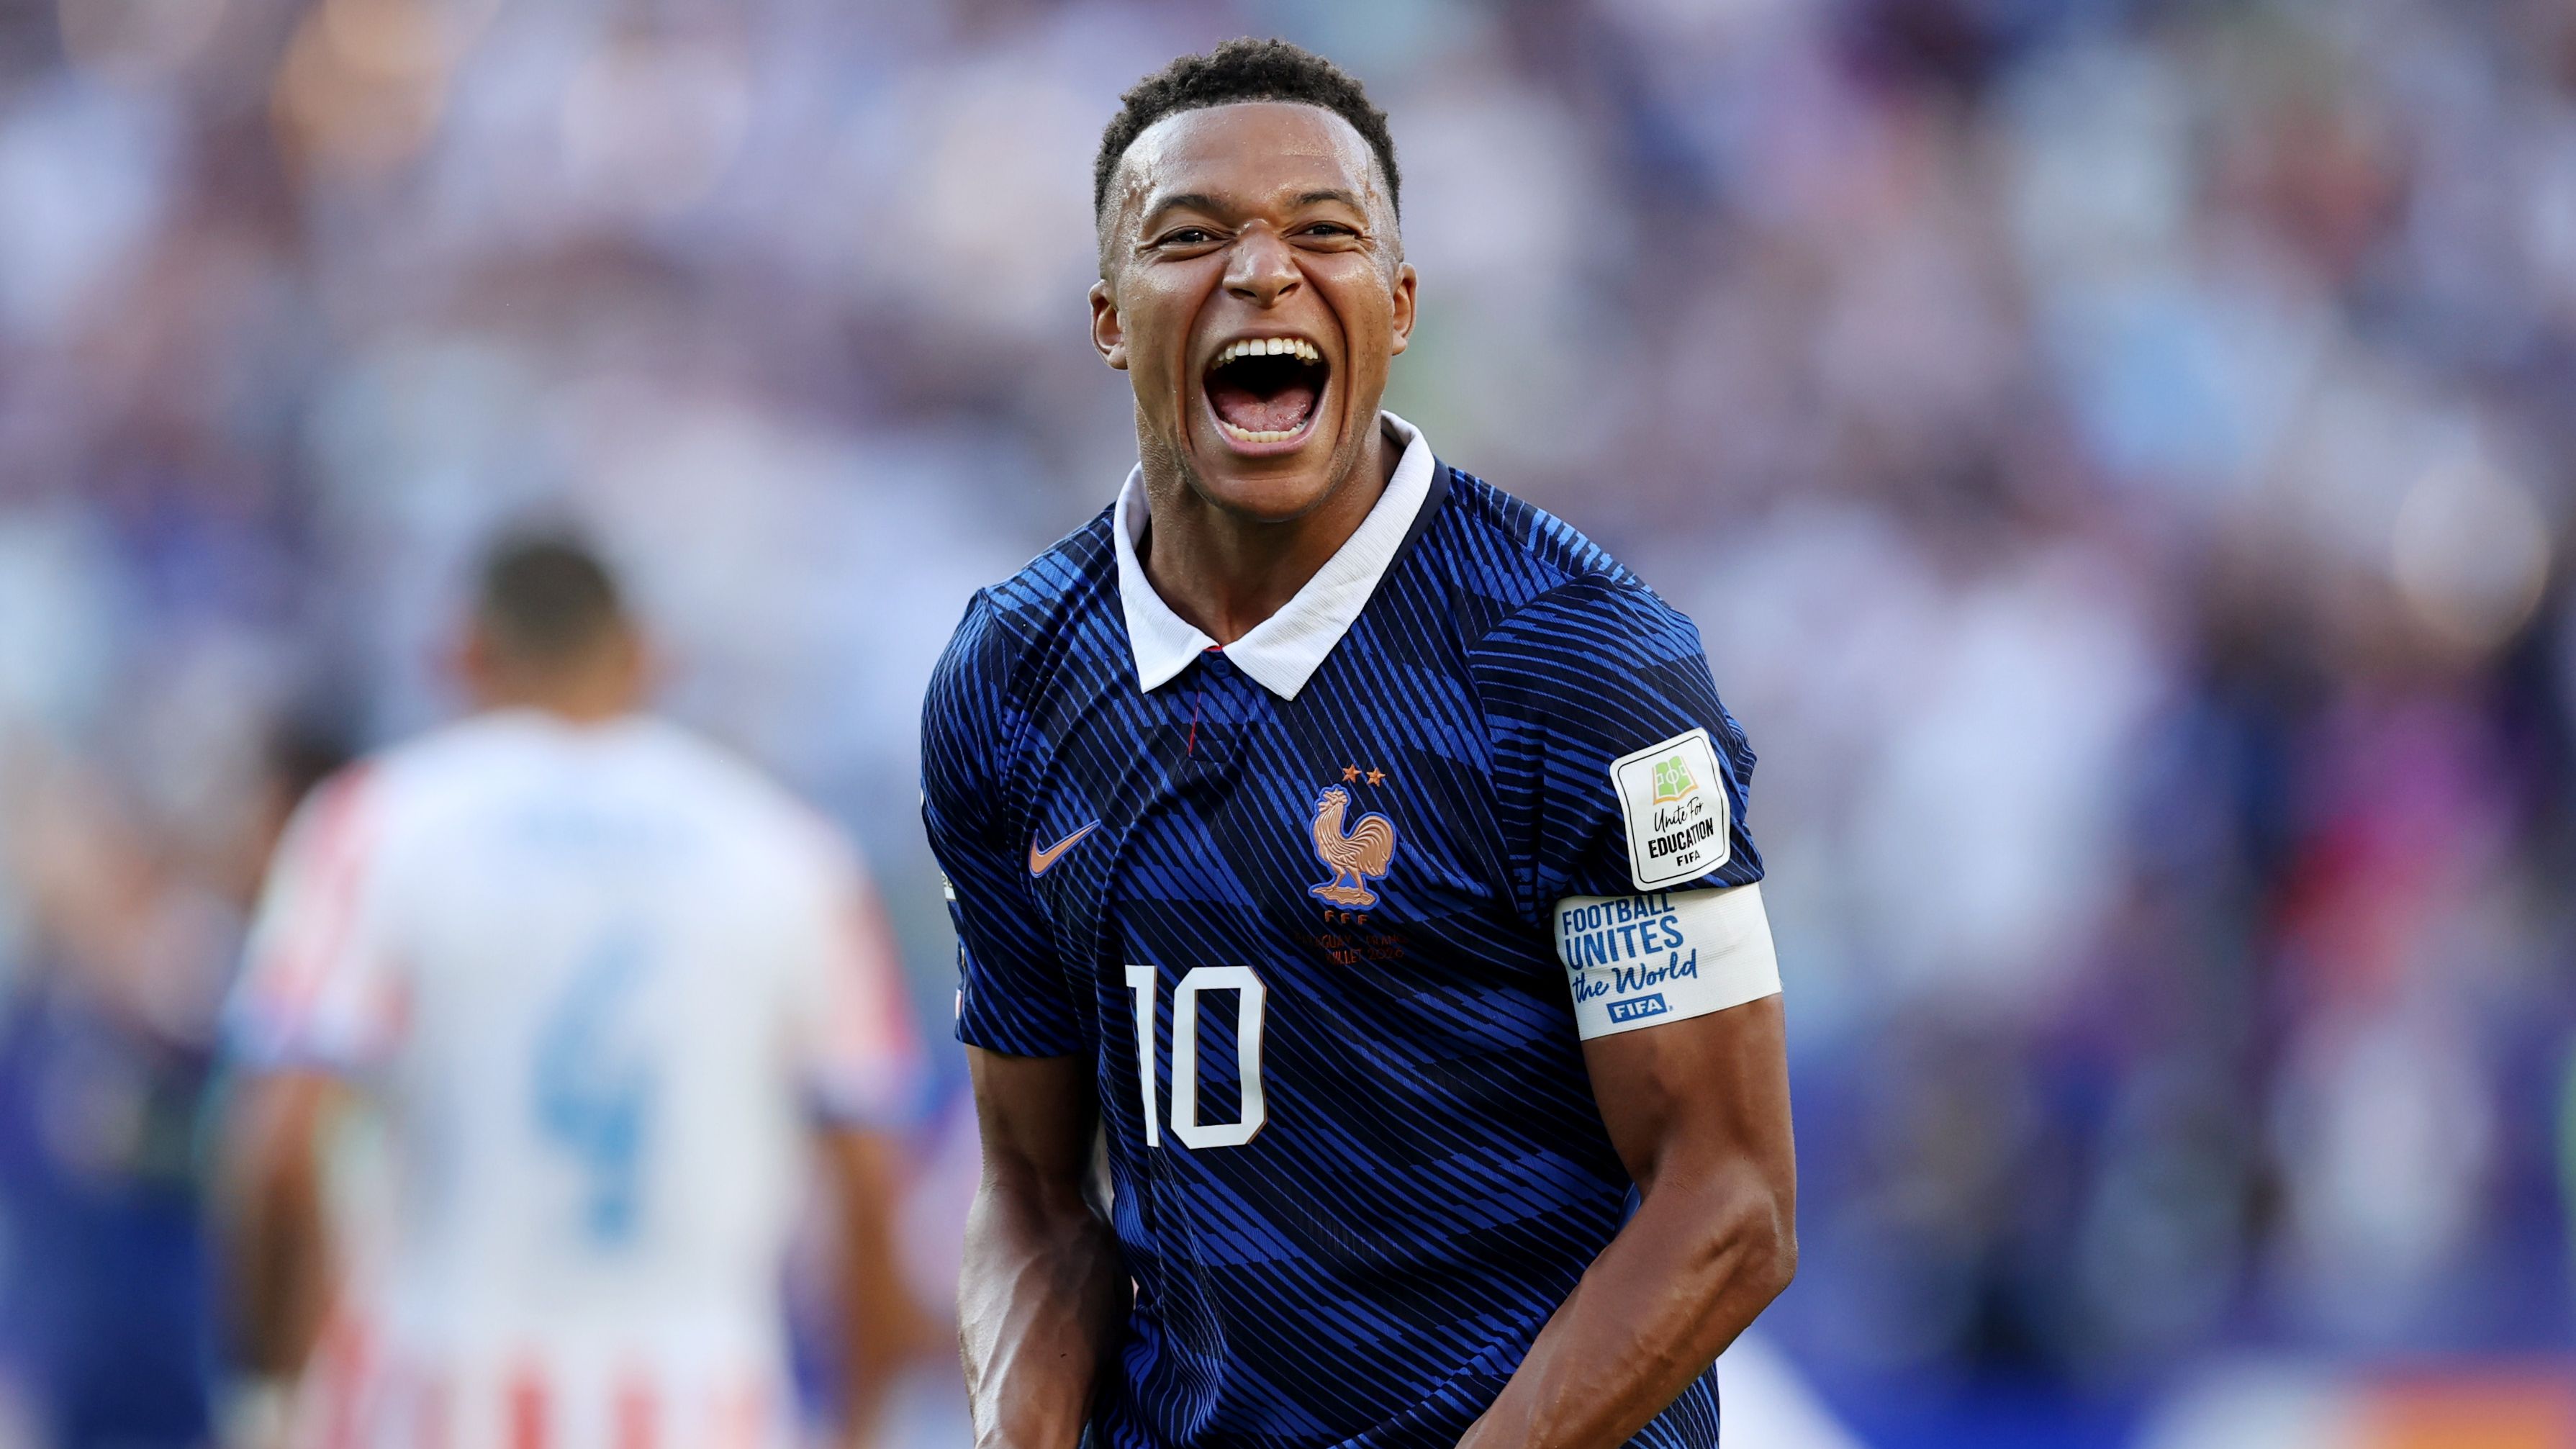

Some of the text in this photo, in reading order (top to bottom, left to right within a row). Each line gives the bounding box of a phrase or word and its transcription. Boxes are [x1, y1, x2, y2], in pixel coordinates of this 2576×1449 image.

[1654, 796, 1704, 833] Unite For
[1648, 817, 1714, 859] EDUCATION
[1676, 849, 1701, 867] FIFA
[1562, 893, 1676, 936] FOOTBALL
[1565, 915, 1684, 971] UNITES
[1572, 947, 1698, 1003] the World
[1612, 998, 1663, 1019] FIFA
[1125, 965, 1268, 1150] 10
